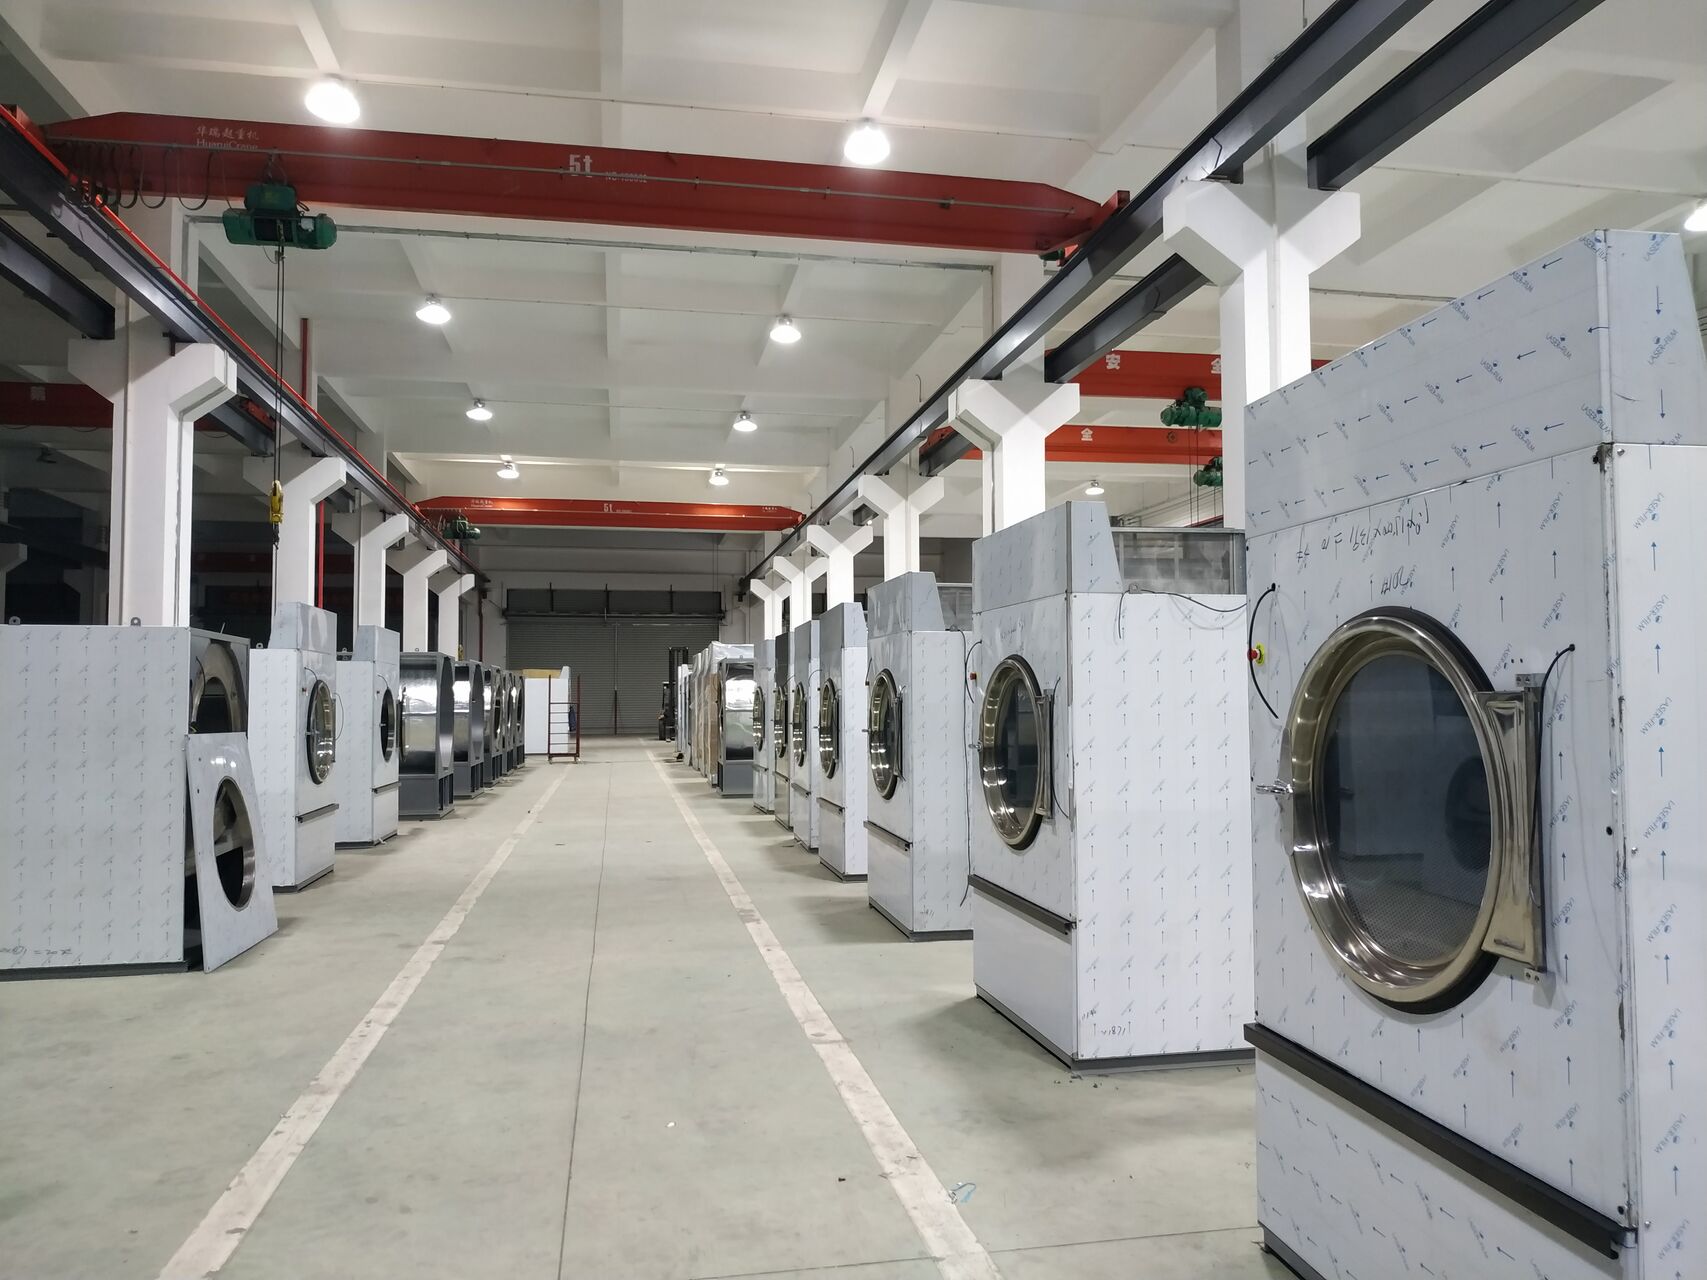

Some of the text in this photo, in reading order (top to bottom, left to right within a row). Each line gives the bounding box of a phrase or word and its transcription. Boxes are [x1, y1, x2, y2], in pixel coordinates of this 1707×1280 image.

[569, 154, 592, 178] 5t
[1648, 329, 1678, 365] LASER-FILM
[1633, 492, 1665, 530] LASER-FILM
[1637, 594, 1669, 632] LASER-FILM
[1640, 696, 1673, 735] LASER-FILM
[1643, 800, 1676, 839] LASER-FILM
[1646, 903, 1678, 943] LASER-FILM
